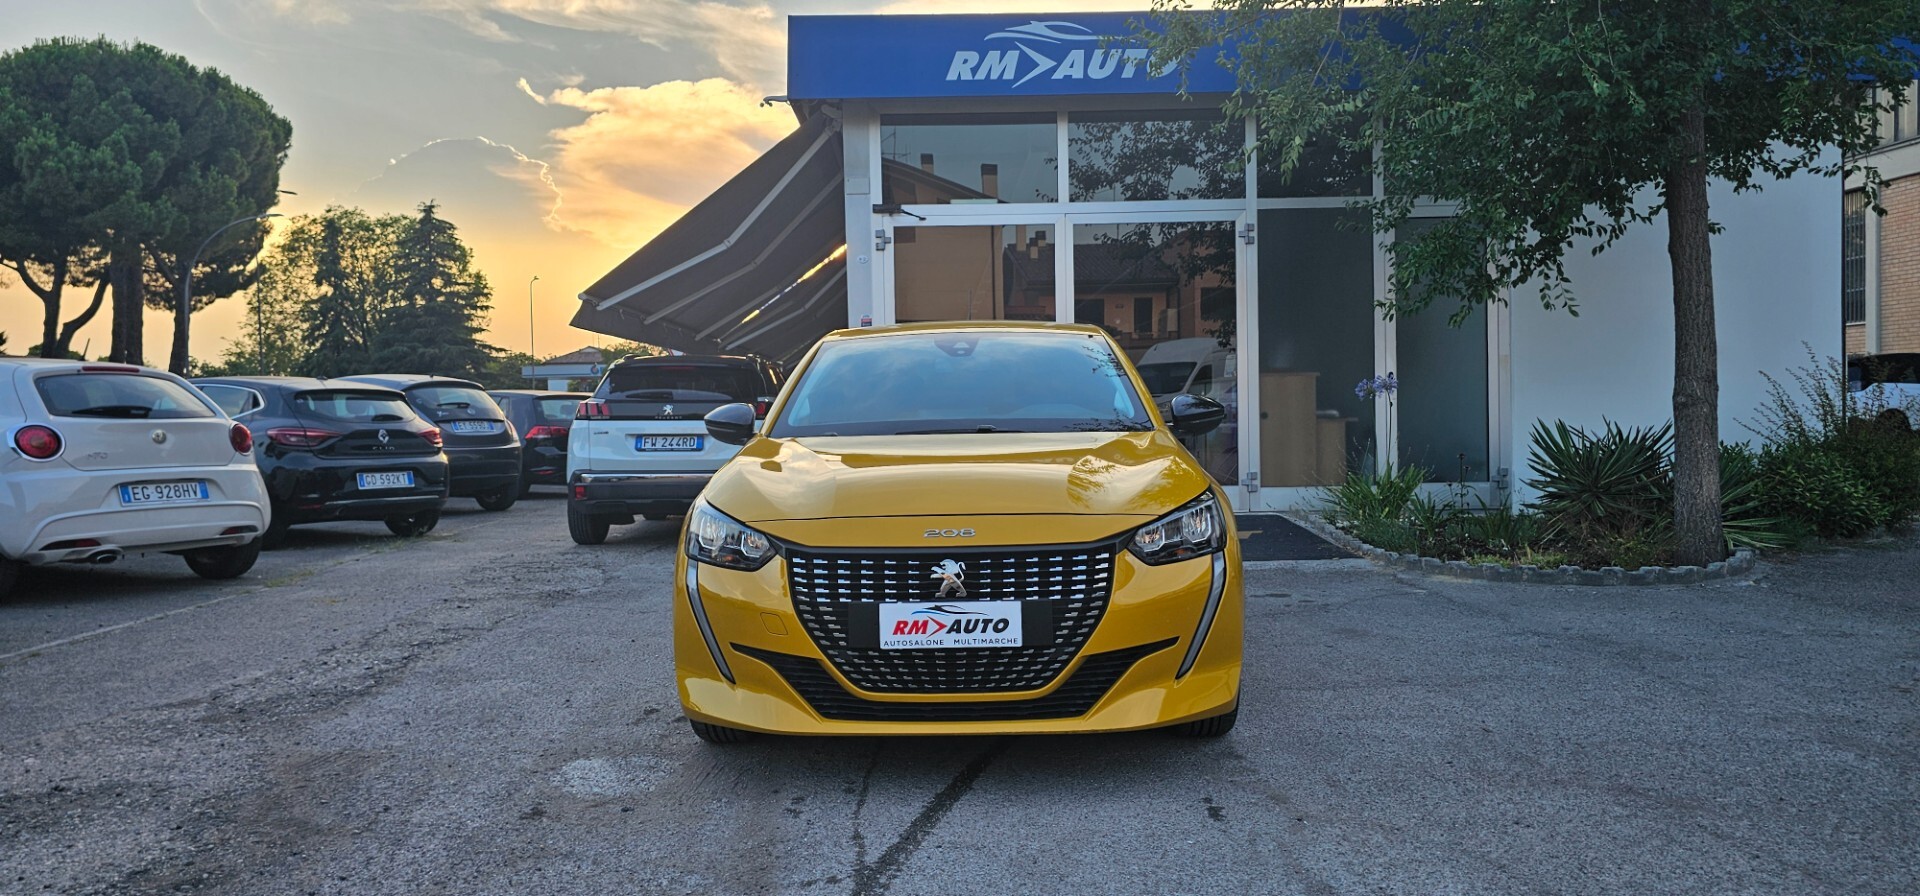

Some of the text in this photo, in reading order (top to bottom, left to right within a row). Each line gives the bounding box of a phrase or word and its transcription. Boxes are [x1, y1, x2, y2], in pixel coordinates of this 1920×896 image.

[945, 50, 1020, 81] RM
[643, 437, 696, 448] FW 244RD
[379, 473, 407, 486] 592KT
[131, 483, 199, 501] EG 928HV
[923, 528, 976, 538] 208
[892, 617, 1010, 636] RM AUTO
[883, 637, 1019, 647] AUTOSALONE MULTIMARCHE
